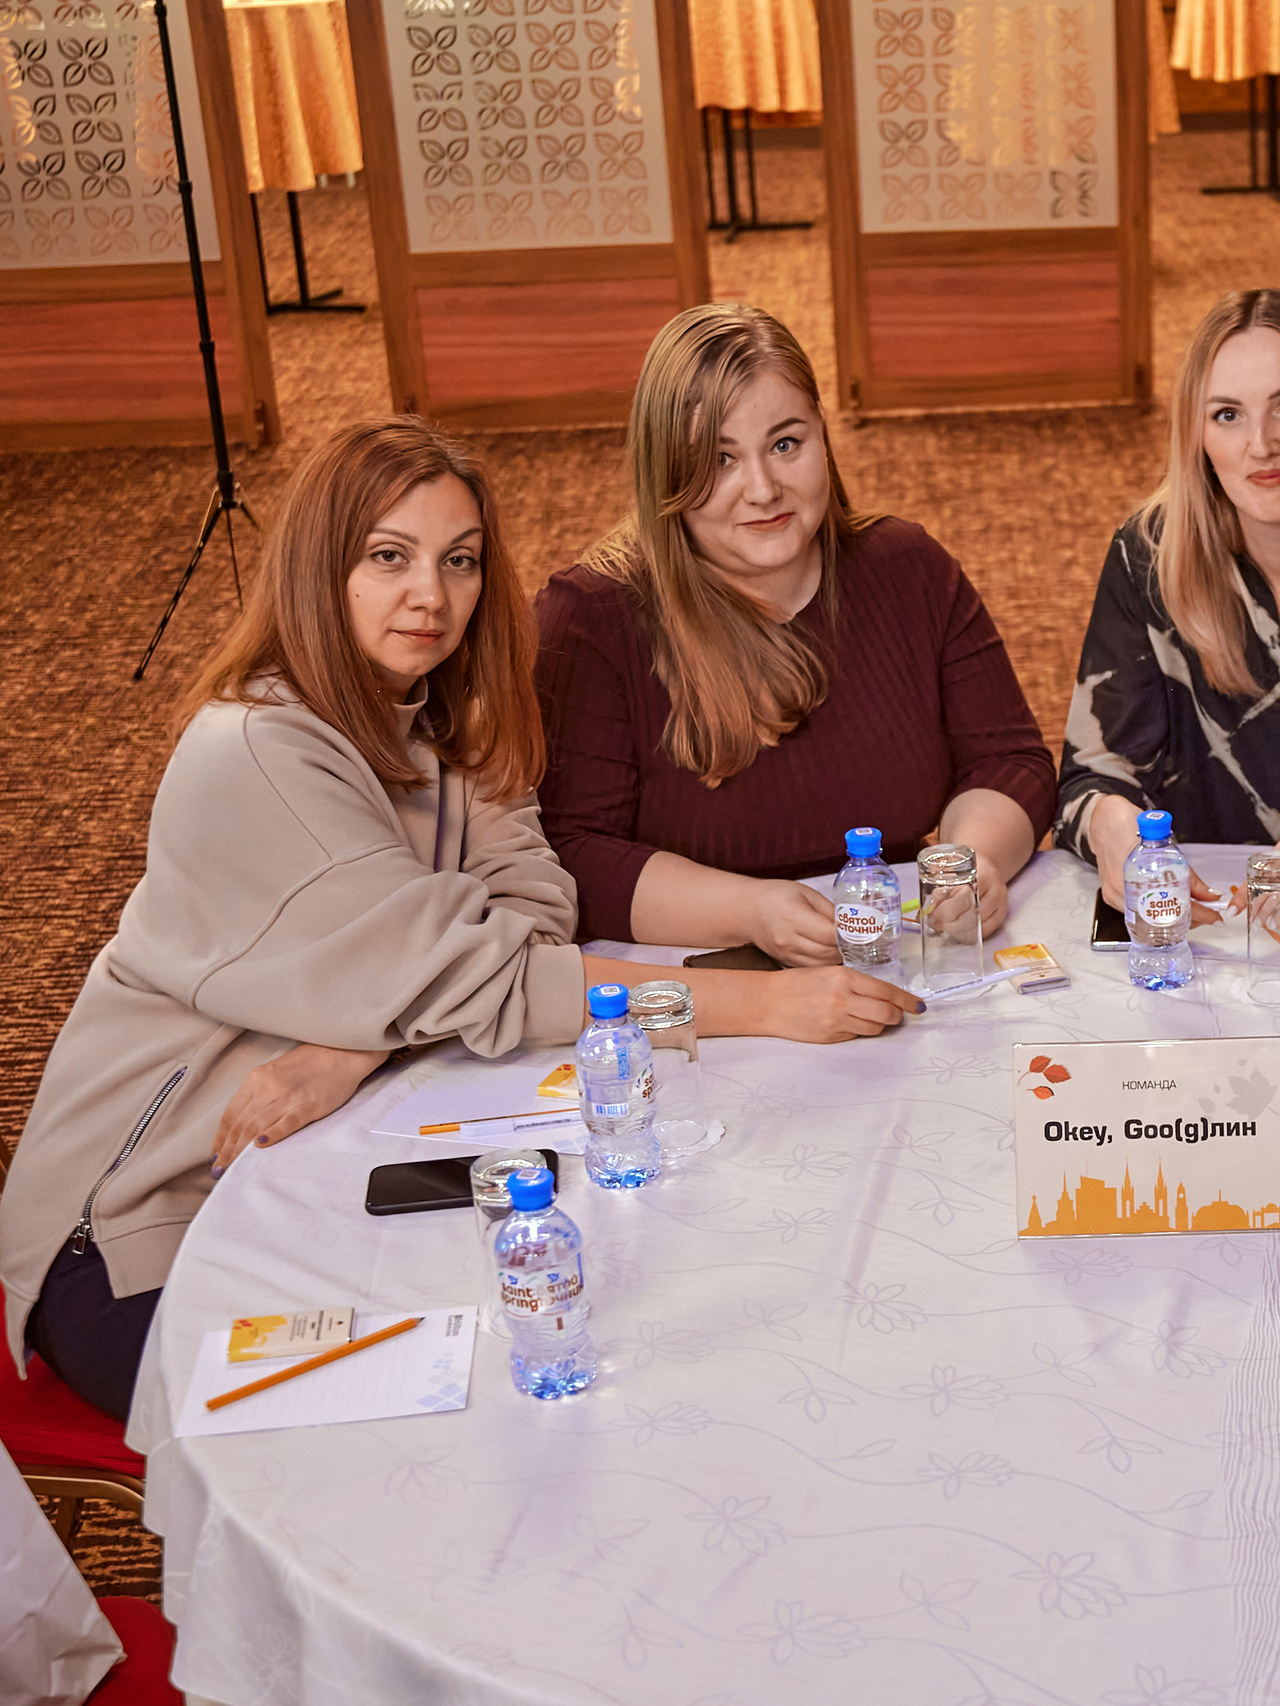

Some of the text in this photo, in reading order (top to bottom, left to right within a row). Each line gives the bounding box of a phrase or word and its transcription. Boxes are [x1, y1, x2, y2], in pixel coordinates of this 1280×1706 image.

[1149, 897, 1178, 909] saint
[838, 912, 876, 926] святой
[1146, 905, 1181, 920] spring
[1122, 1080, 1177, 1091] КОМАНДА
[1044, 1117, 1257, 1146] Okey, Goo(g)лин
